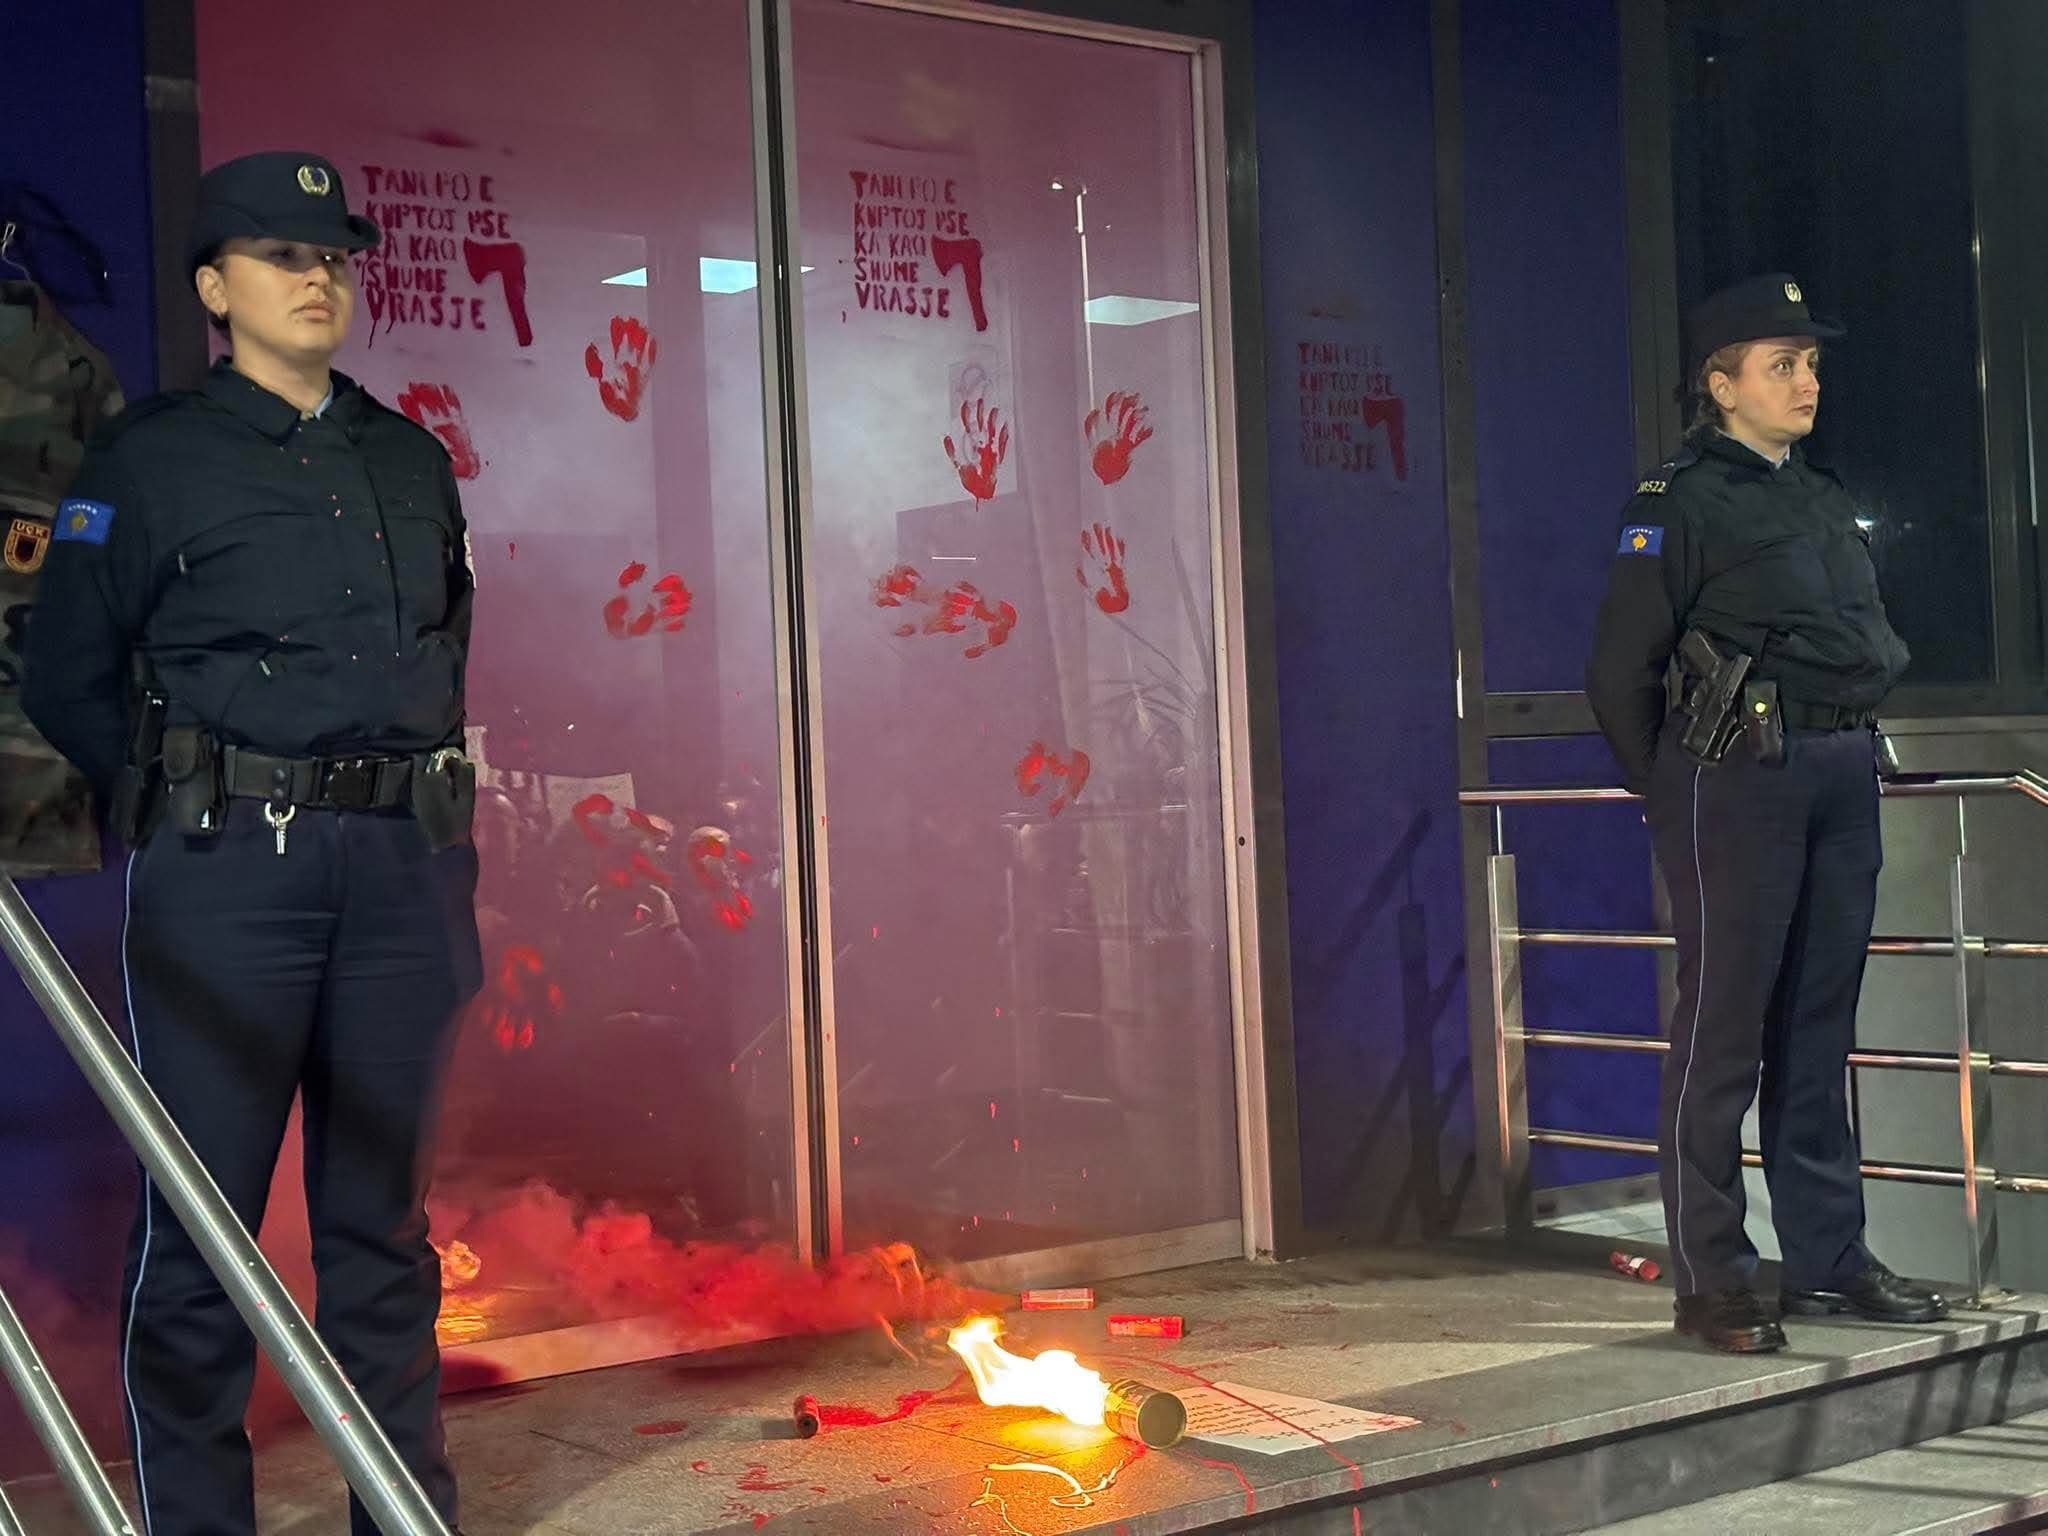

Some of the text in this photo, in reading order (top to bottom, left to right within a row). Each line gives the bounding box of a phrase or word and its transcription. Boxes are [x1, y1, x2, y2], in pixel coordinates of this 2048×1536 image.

[361, 166, 428, 197] TANI
[479, 175, 495, 203] E
[849, 171, 903, 199] TANI
[943, 177, 957, 203] E
[365, 200, 456, 231] KUPTOJ
[854, 202, 926, 230] KUPTOJ
[854, 231, 880, 256] KA
[364, 260, 448, 293] SHUME
[853, 256, 920, 283] SHUME
[365, 287, 487, 330] VRASJE
[855, 282, 950, 318] VRASJE
